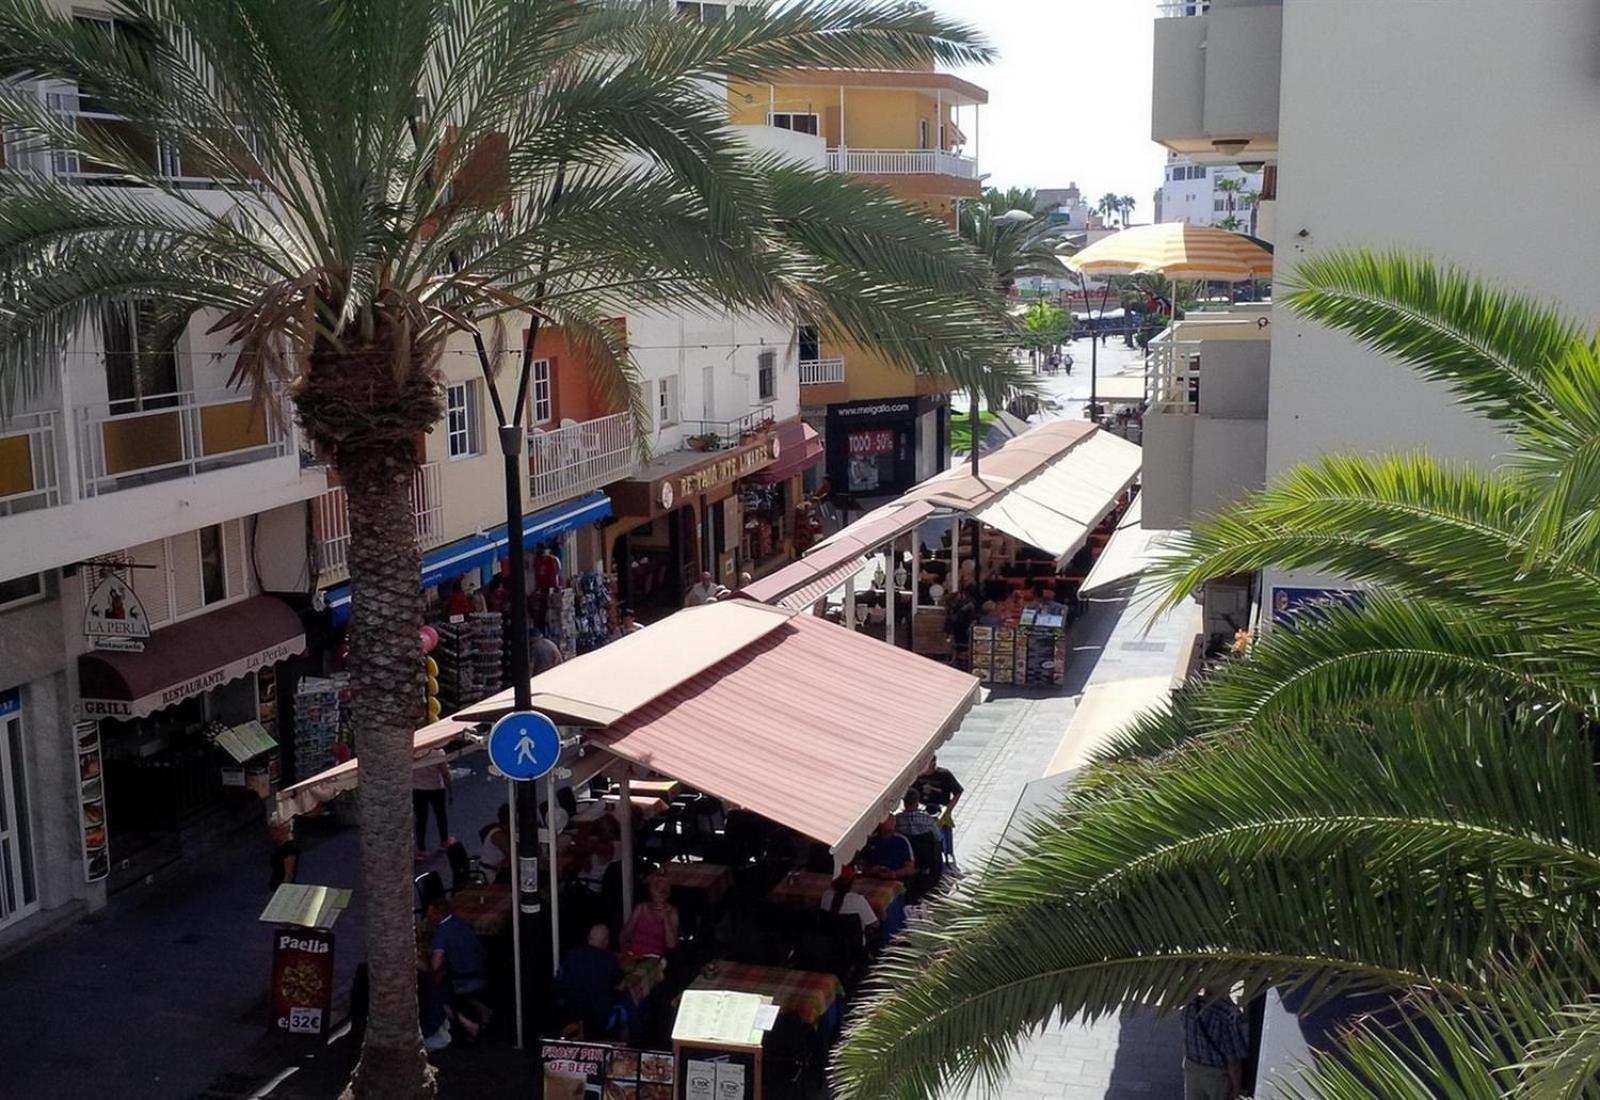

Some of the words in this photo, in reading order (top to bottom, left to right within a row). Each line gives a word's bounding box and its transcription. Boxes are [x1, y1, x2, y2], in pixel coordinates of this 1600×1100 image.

[848, 434, 871, 452] TODO
[87, 621, 104, 633] LA
[107, 621, 148, 635] PERLA
[162, 670, 226, 704] RESTAURANTE
[246, 656, 260, 669] La
[262, 646, 288, 664] Perla
[85, 702, 131, 715] GRILL
[279, 935, 329, 954] Paella
[290, 1015, 319, 1029] 32€
[550, 1061, 564, 1073] OF
[568, 1062, 598, 1076] BEER
